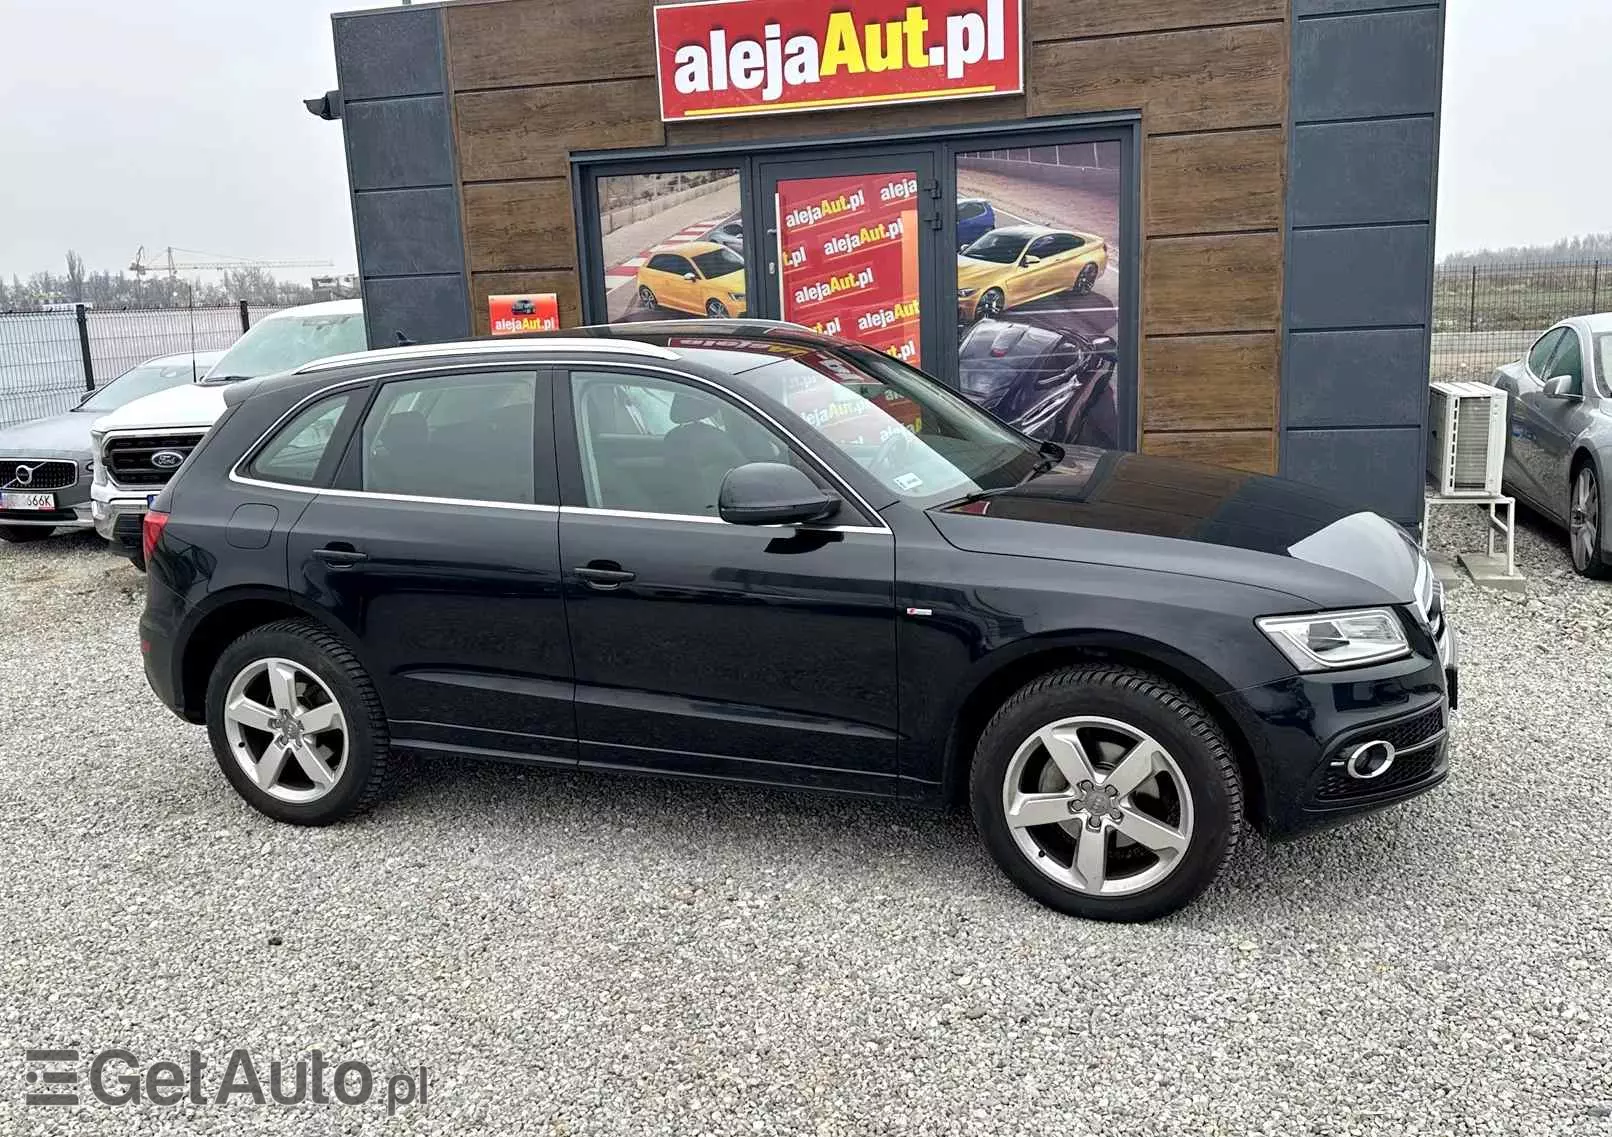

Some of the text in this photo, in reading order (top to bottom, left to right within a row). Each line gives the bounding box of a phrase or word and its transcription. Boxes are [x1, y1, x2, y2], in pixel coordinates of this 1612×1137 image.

[674, 0, 1005, 101] alejaAut.pl
[880, 178, 918, 201] aleja
[786, 189, 865, 228] alejaAut.pl
[823, 218, 904, 256] alejaAut.pl
[794, 268, 874, 304] alejaAut.pl
[495, 317, 555, 333] alejaAut.pl
